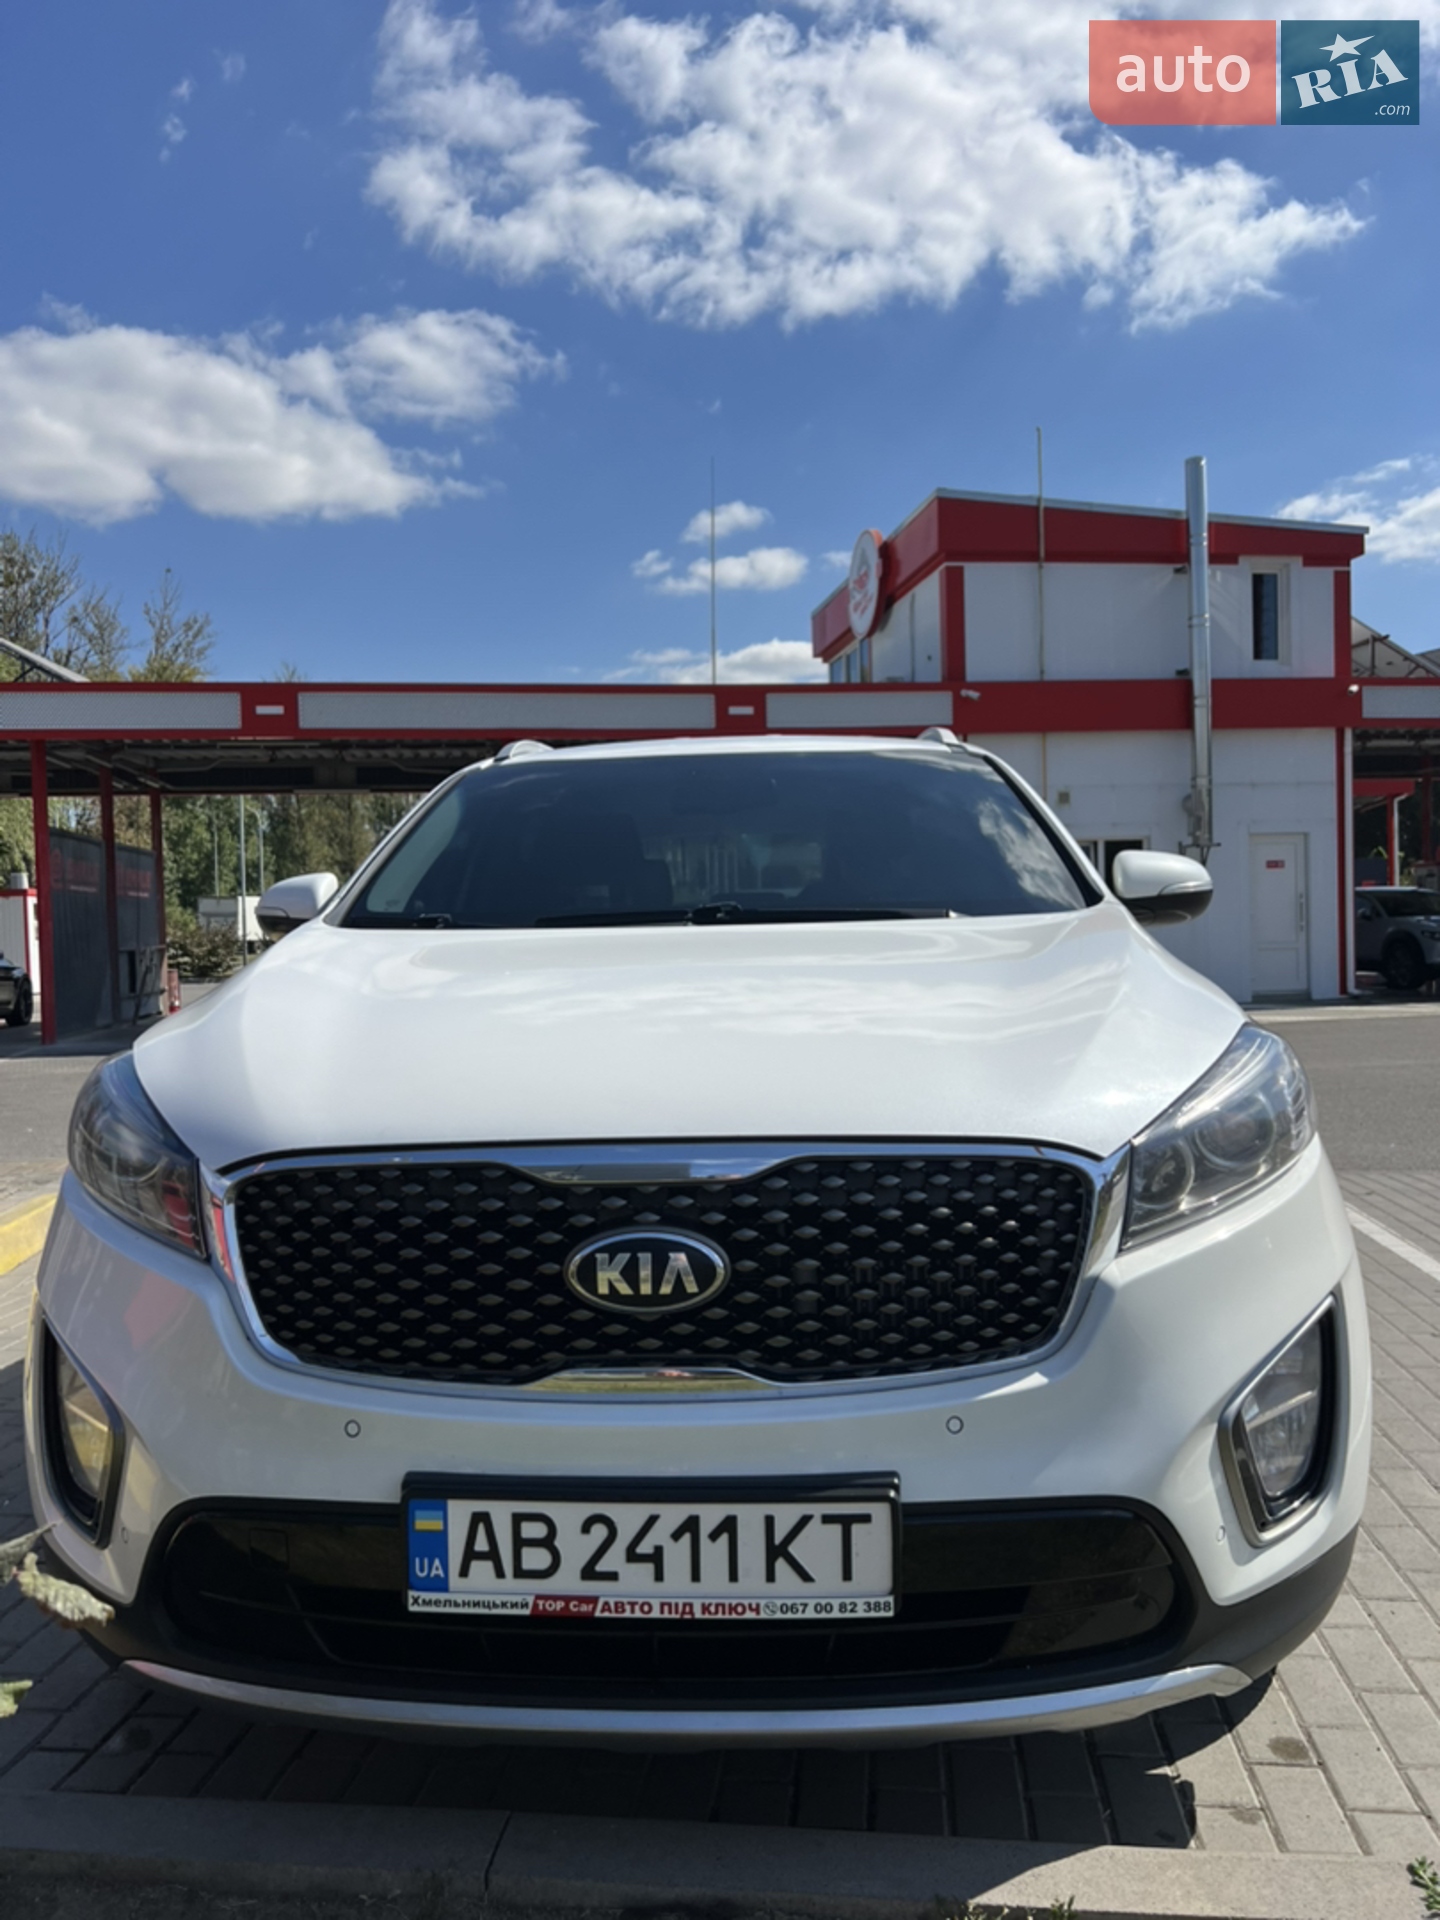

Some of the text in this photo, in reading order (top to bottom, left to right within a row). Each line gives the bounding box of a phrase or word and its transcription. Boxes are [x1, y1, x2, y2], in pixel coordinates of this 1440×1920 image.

[594, 1251, 700, 1295] KIA
[458, 1511, 873, 1583] AB 2411 KT
[415, 1557, 445, 1578] UA
[410, 1594, 892, 1619] Хмельницький TOP Car АВТО ПІД КЛЮЧ 067 00 82 388
